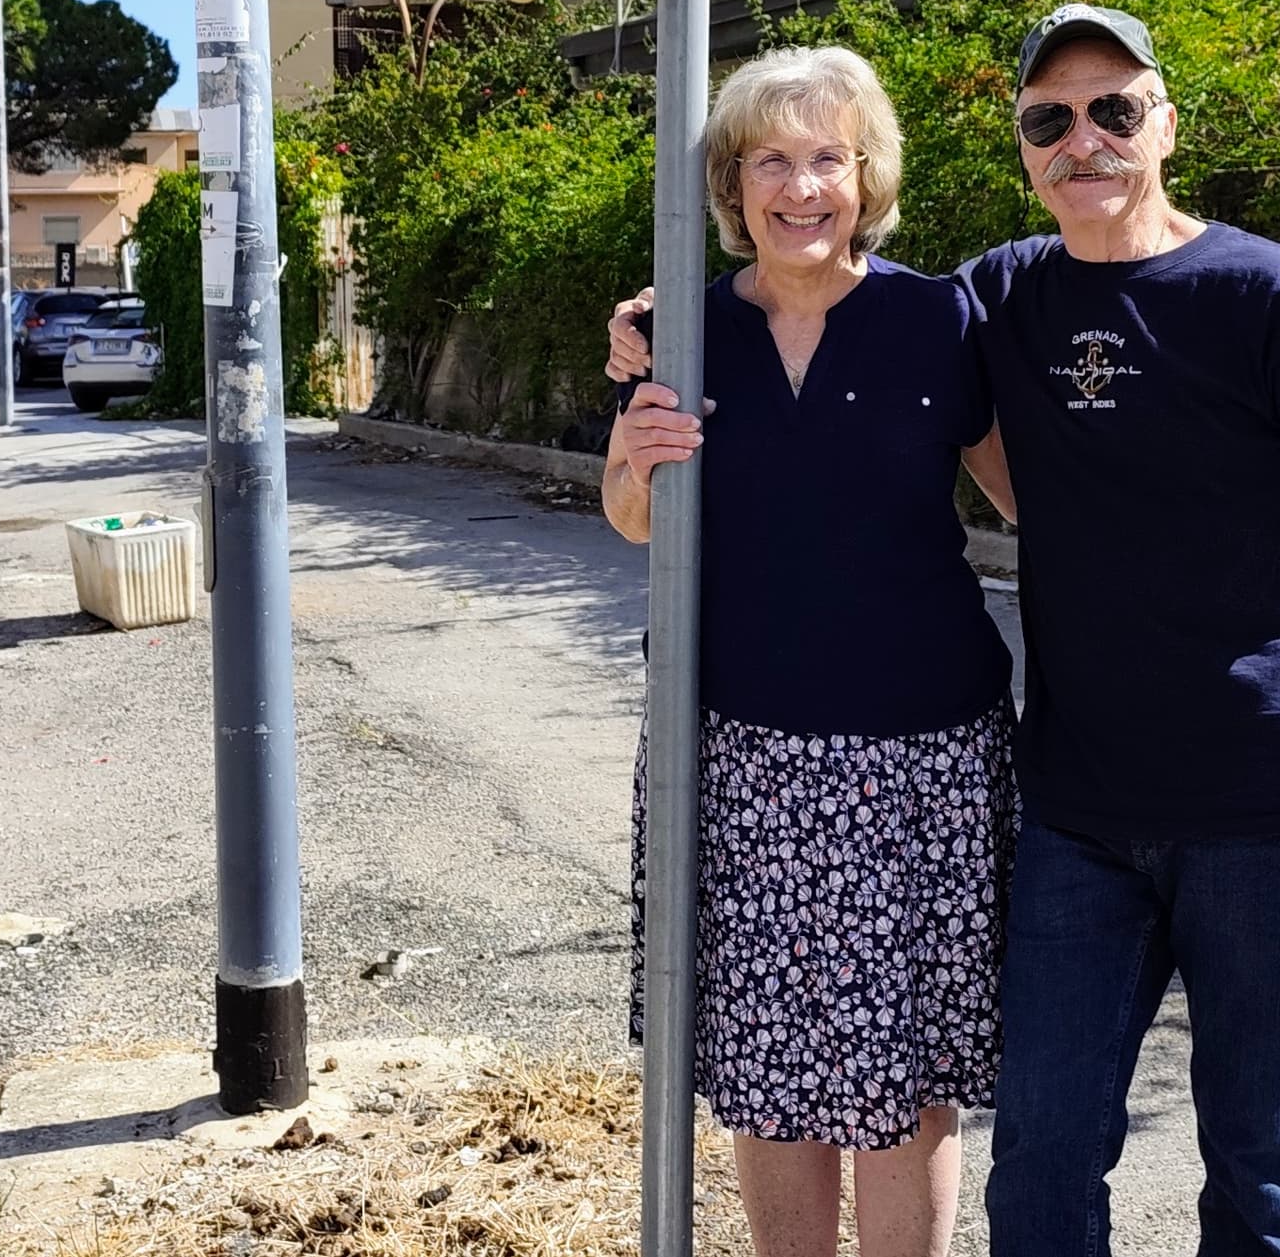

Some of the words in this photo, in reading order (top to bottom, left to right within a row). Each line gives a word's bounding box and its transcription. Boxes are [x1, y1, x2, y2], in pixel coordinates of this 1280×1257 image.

[1071, 329, 1126, 349] GRENADA
[1067, 400, 1090, 410] WEST
[1092, 399, 1117, 409] INDIES
